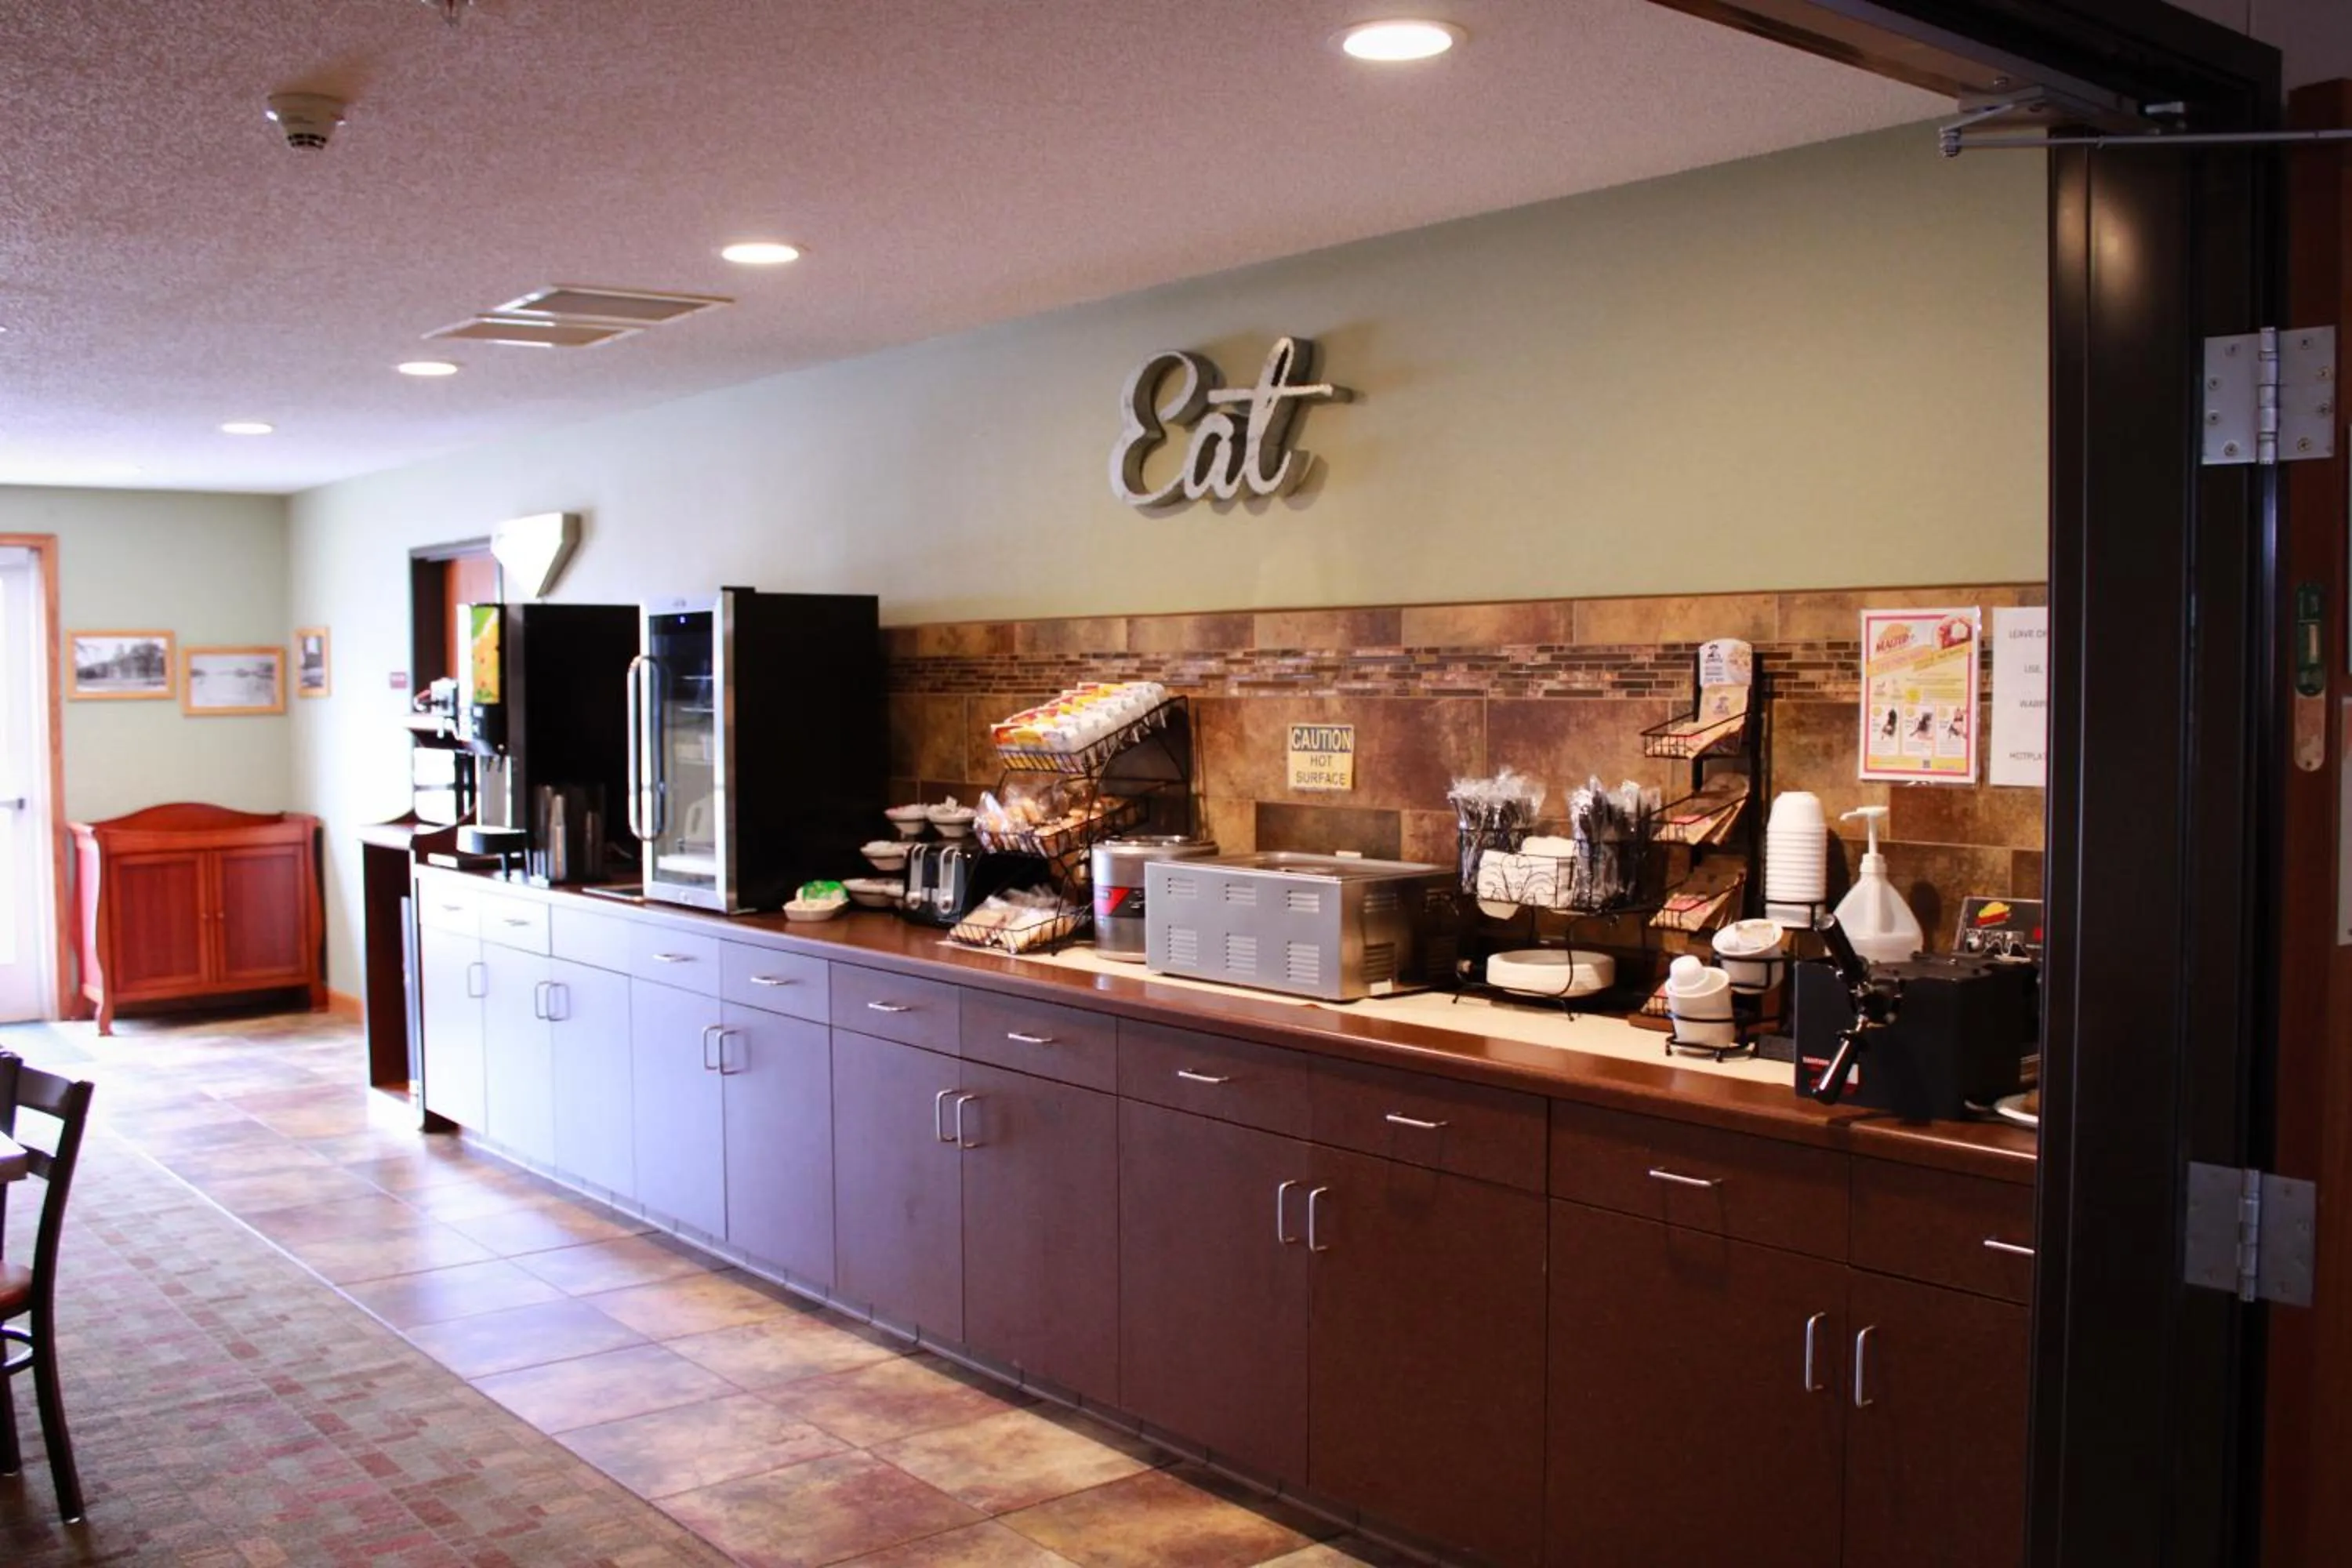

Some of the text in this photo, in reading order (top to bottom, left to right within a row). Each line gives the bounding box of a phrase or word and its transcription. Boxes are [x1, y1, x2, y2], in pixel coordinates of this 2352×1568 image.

[1109, 336, 1337, 506] Eat
[2009, 630, 2034, 639] LEAVE
[1292, 728, 1351, 750] CAUTION
[1310, 755, 1332, 766] HOT
[1296, 771, 1346, 786] SURFACE
